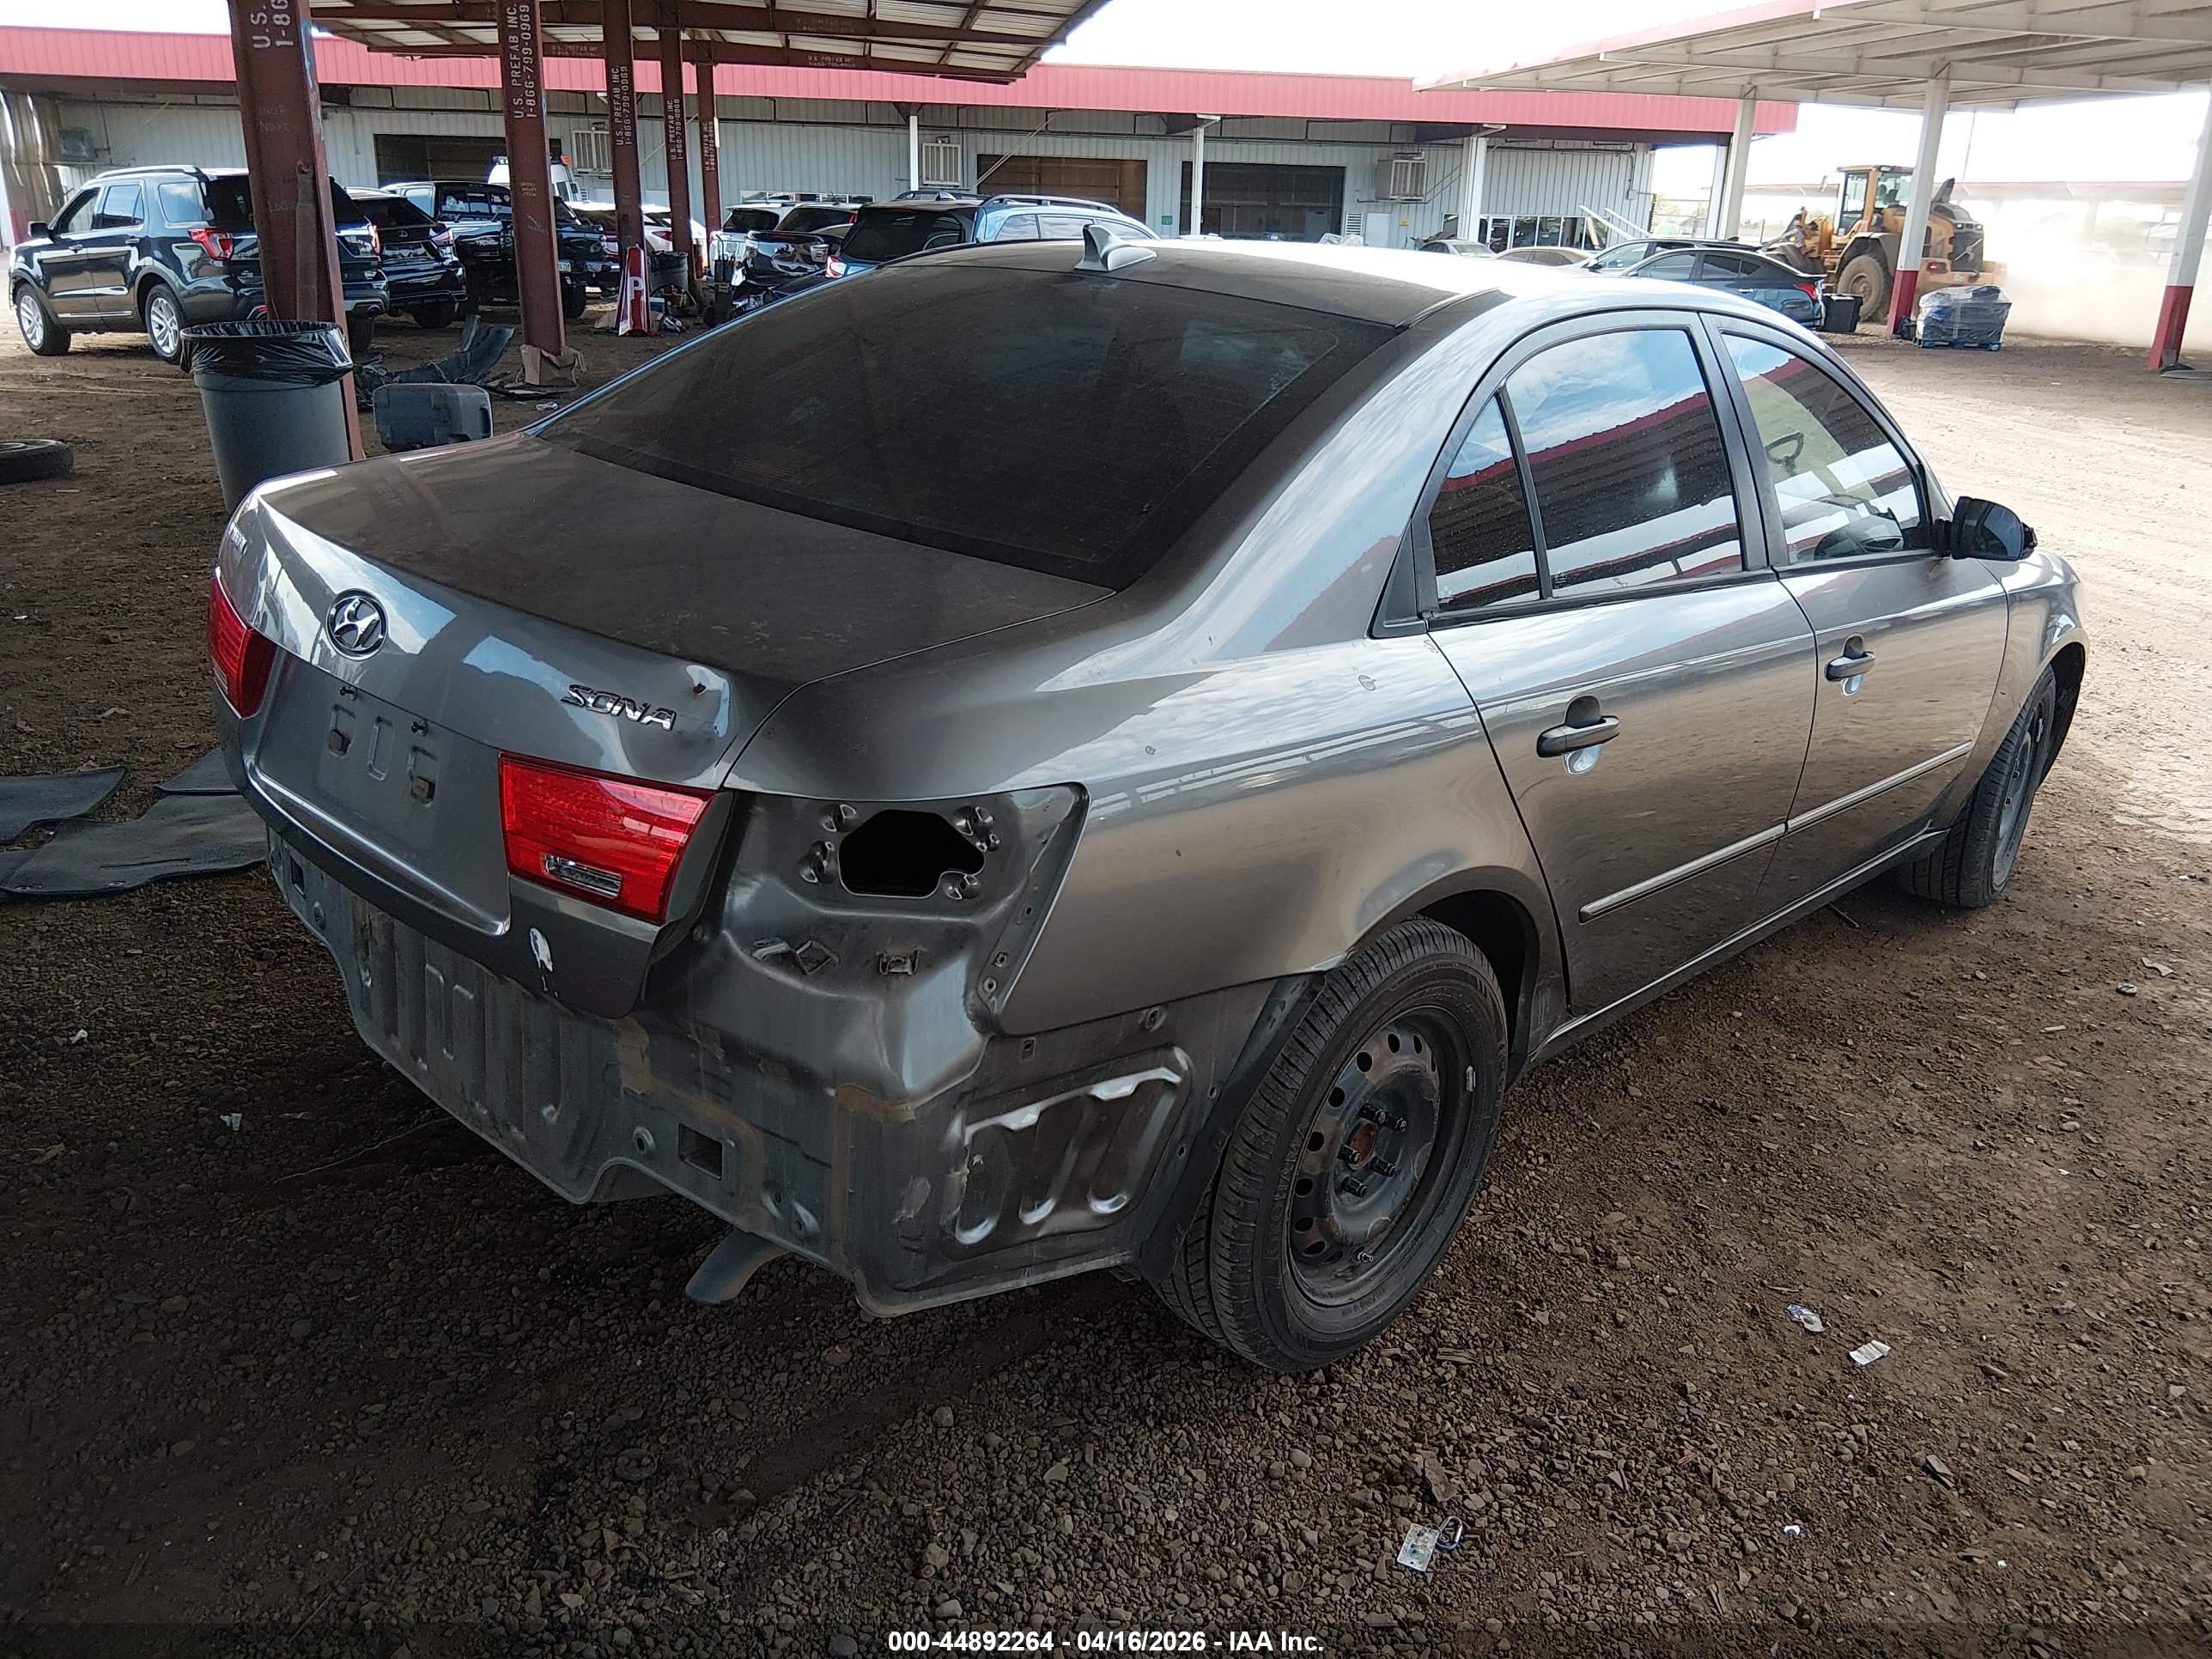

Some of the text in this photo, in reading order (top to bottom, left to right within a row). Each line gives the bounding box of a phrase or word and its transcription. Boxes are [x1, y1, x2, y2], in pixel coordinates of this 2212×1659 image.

[250, 4, 271, 49] U.S.
[507, 3, 525, 118] U.S. PREFAB INC.
[520, 4, 538, 118] 1-866-799-0969
[612, 86, 623, 124] PREFAB
[615, 129, 625, 146] U.S.
[560, 684, 678, 731] SONA
